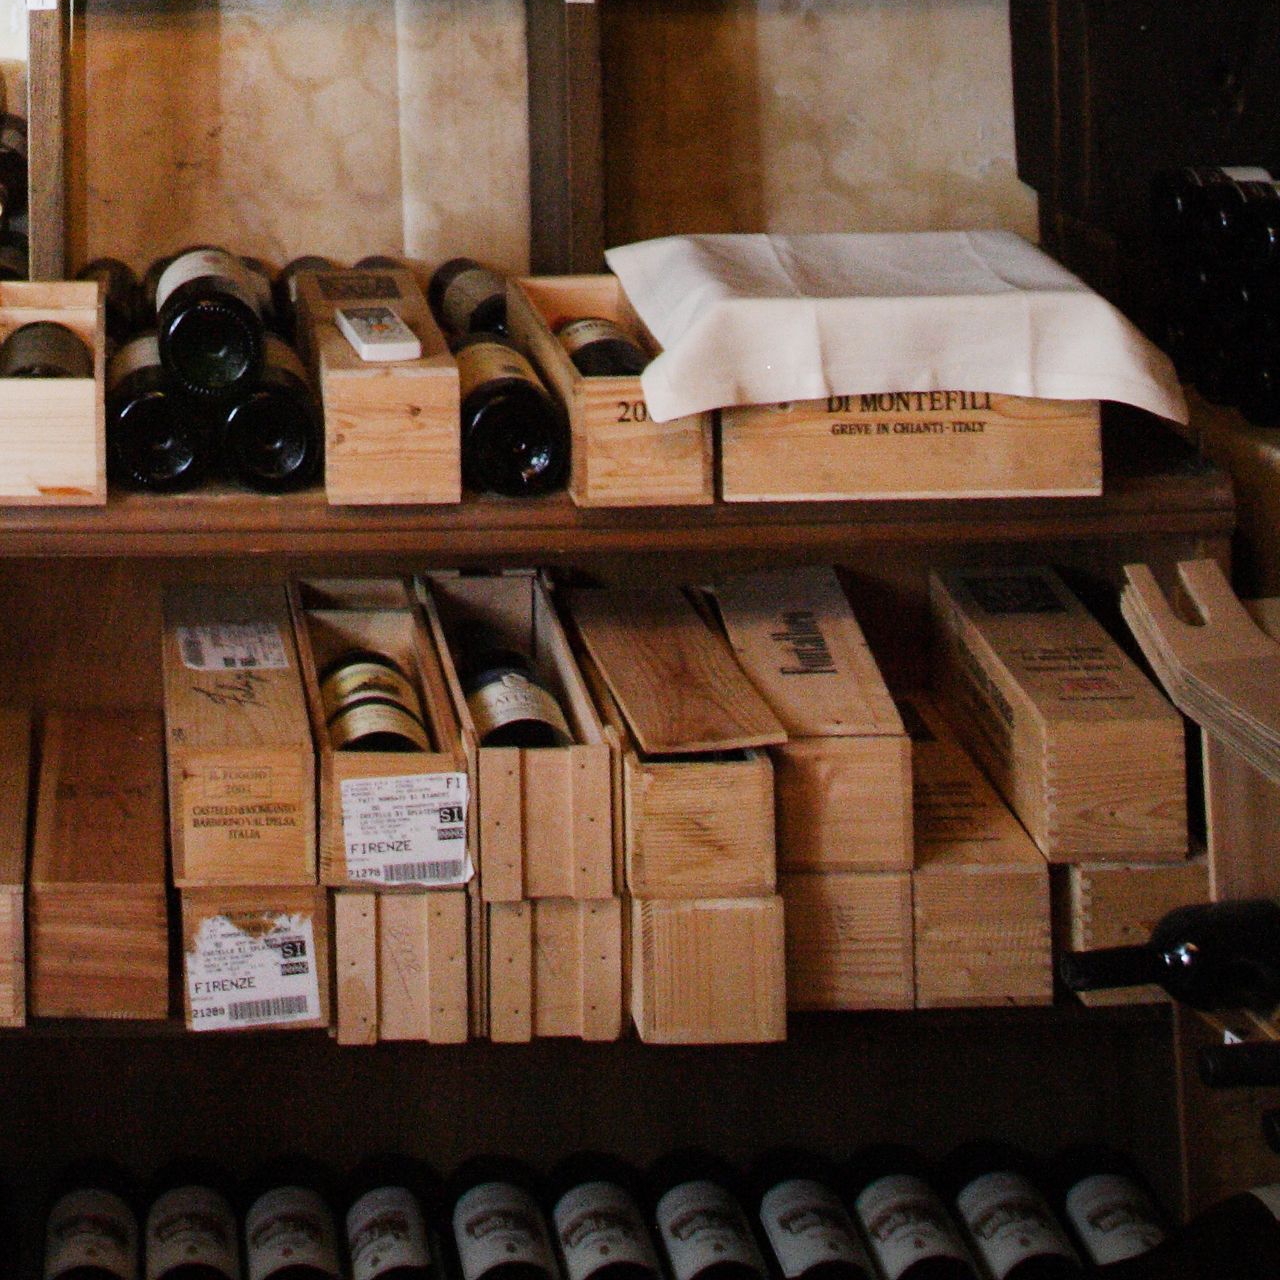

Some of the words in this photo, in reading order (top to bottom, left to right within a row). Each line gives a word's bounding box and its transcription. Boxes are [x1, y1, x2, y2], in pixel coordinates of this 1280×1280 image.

[827, 393, 851, 413] DI
[860, 390, 992, 412] MONTEFILI
[831, 423, 872, 436] GREVE
[876, 422, 890, 434] IN
[192, 805, 237, 816] CASTELLO
[440, 807, 462, 823] SI
[228, 829, 262, 840] ITALIA
[350, 839, 413, 855] FIRENZE
[282, 942, 304, 959] SI
[193, 976, 257, 994] FIRENZE
